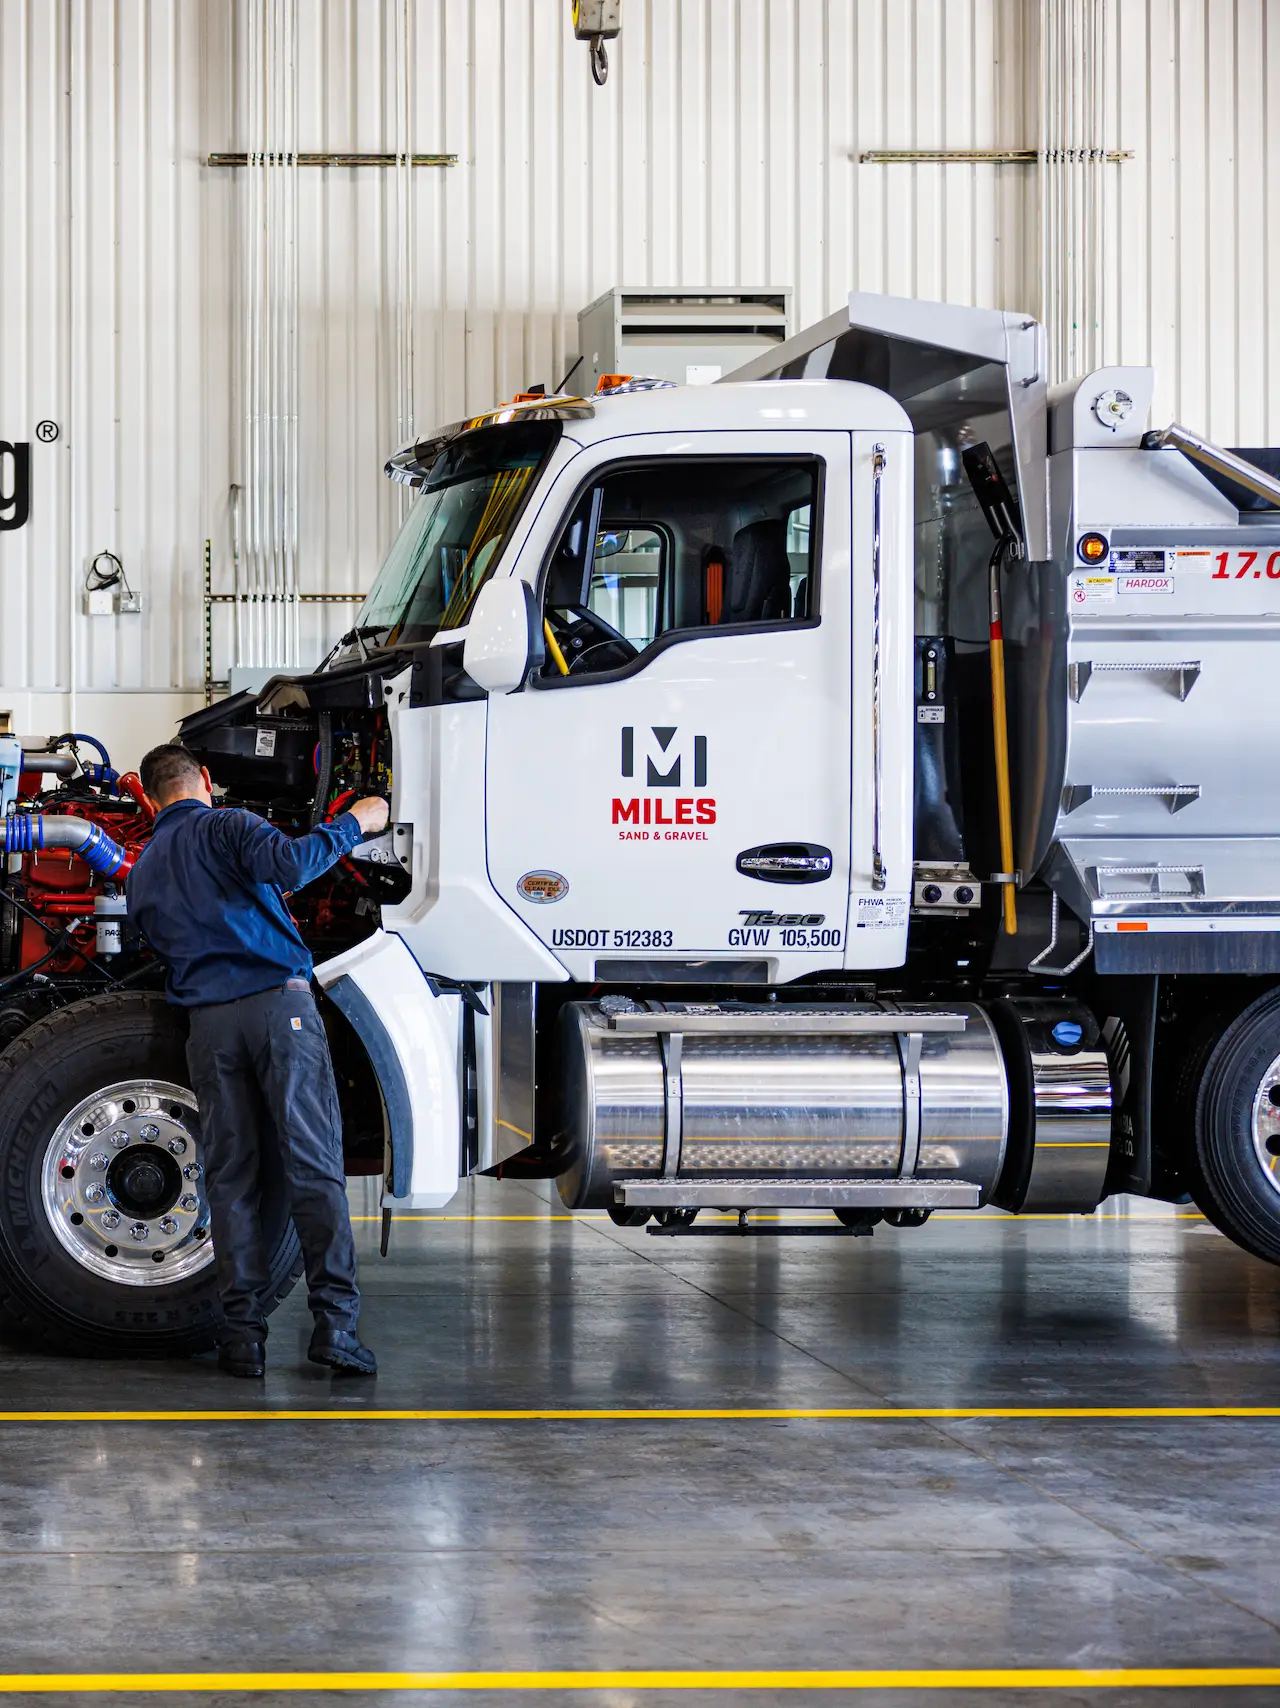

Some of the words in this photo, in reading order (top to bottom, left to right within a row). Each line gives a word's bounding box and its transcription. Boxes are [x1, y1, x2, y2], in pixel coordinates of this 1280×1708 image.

[1125, 579, 1169, 588] HARDOX
[612, 798, 716, 824] MILES
[619, 831, 649, 841] SAND
[653, 831, 660, 841] &
[665, 831, 708, 841] GRAVEL
[738, 910, 826, 926] T880
[552, 929, 610, 946] USDOT
[613, 930, 673, 947] 512383
[728, 929, 770, 946] GVW
[780, 929, 841, 948] 105,500
[8, 1080, 62, 1227] MICHELIN
